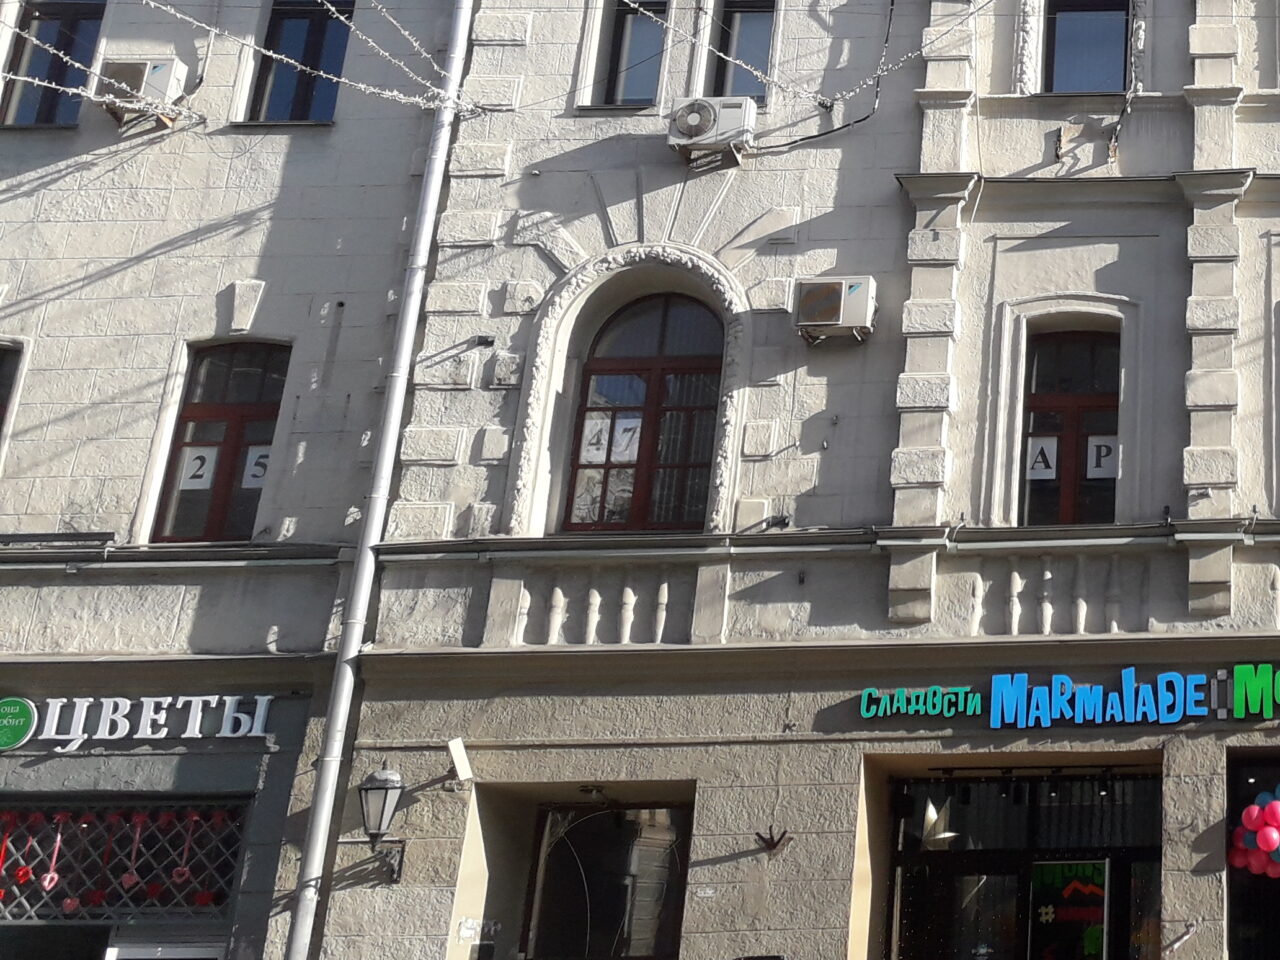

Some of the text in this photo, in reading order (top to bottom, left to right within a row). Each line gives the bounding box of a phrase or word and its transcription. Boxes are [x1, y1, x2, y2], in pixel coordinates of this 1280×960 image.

[188, 454, 270, 480] 2 5
[860, 685, 981, 719] СЛАДОСТИ
[989, 666, 1209, 729] MARMALADE
[38, 695, 275, 752] ЦВЕТЫ
